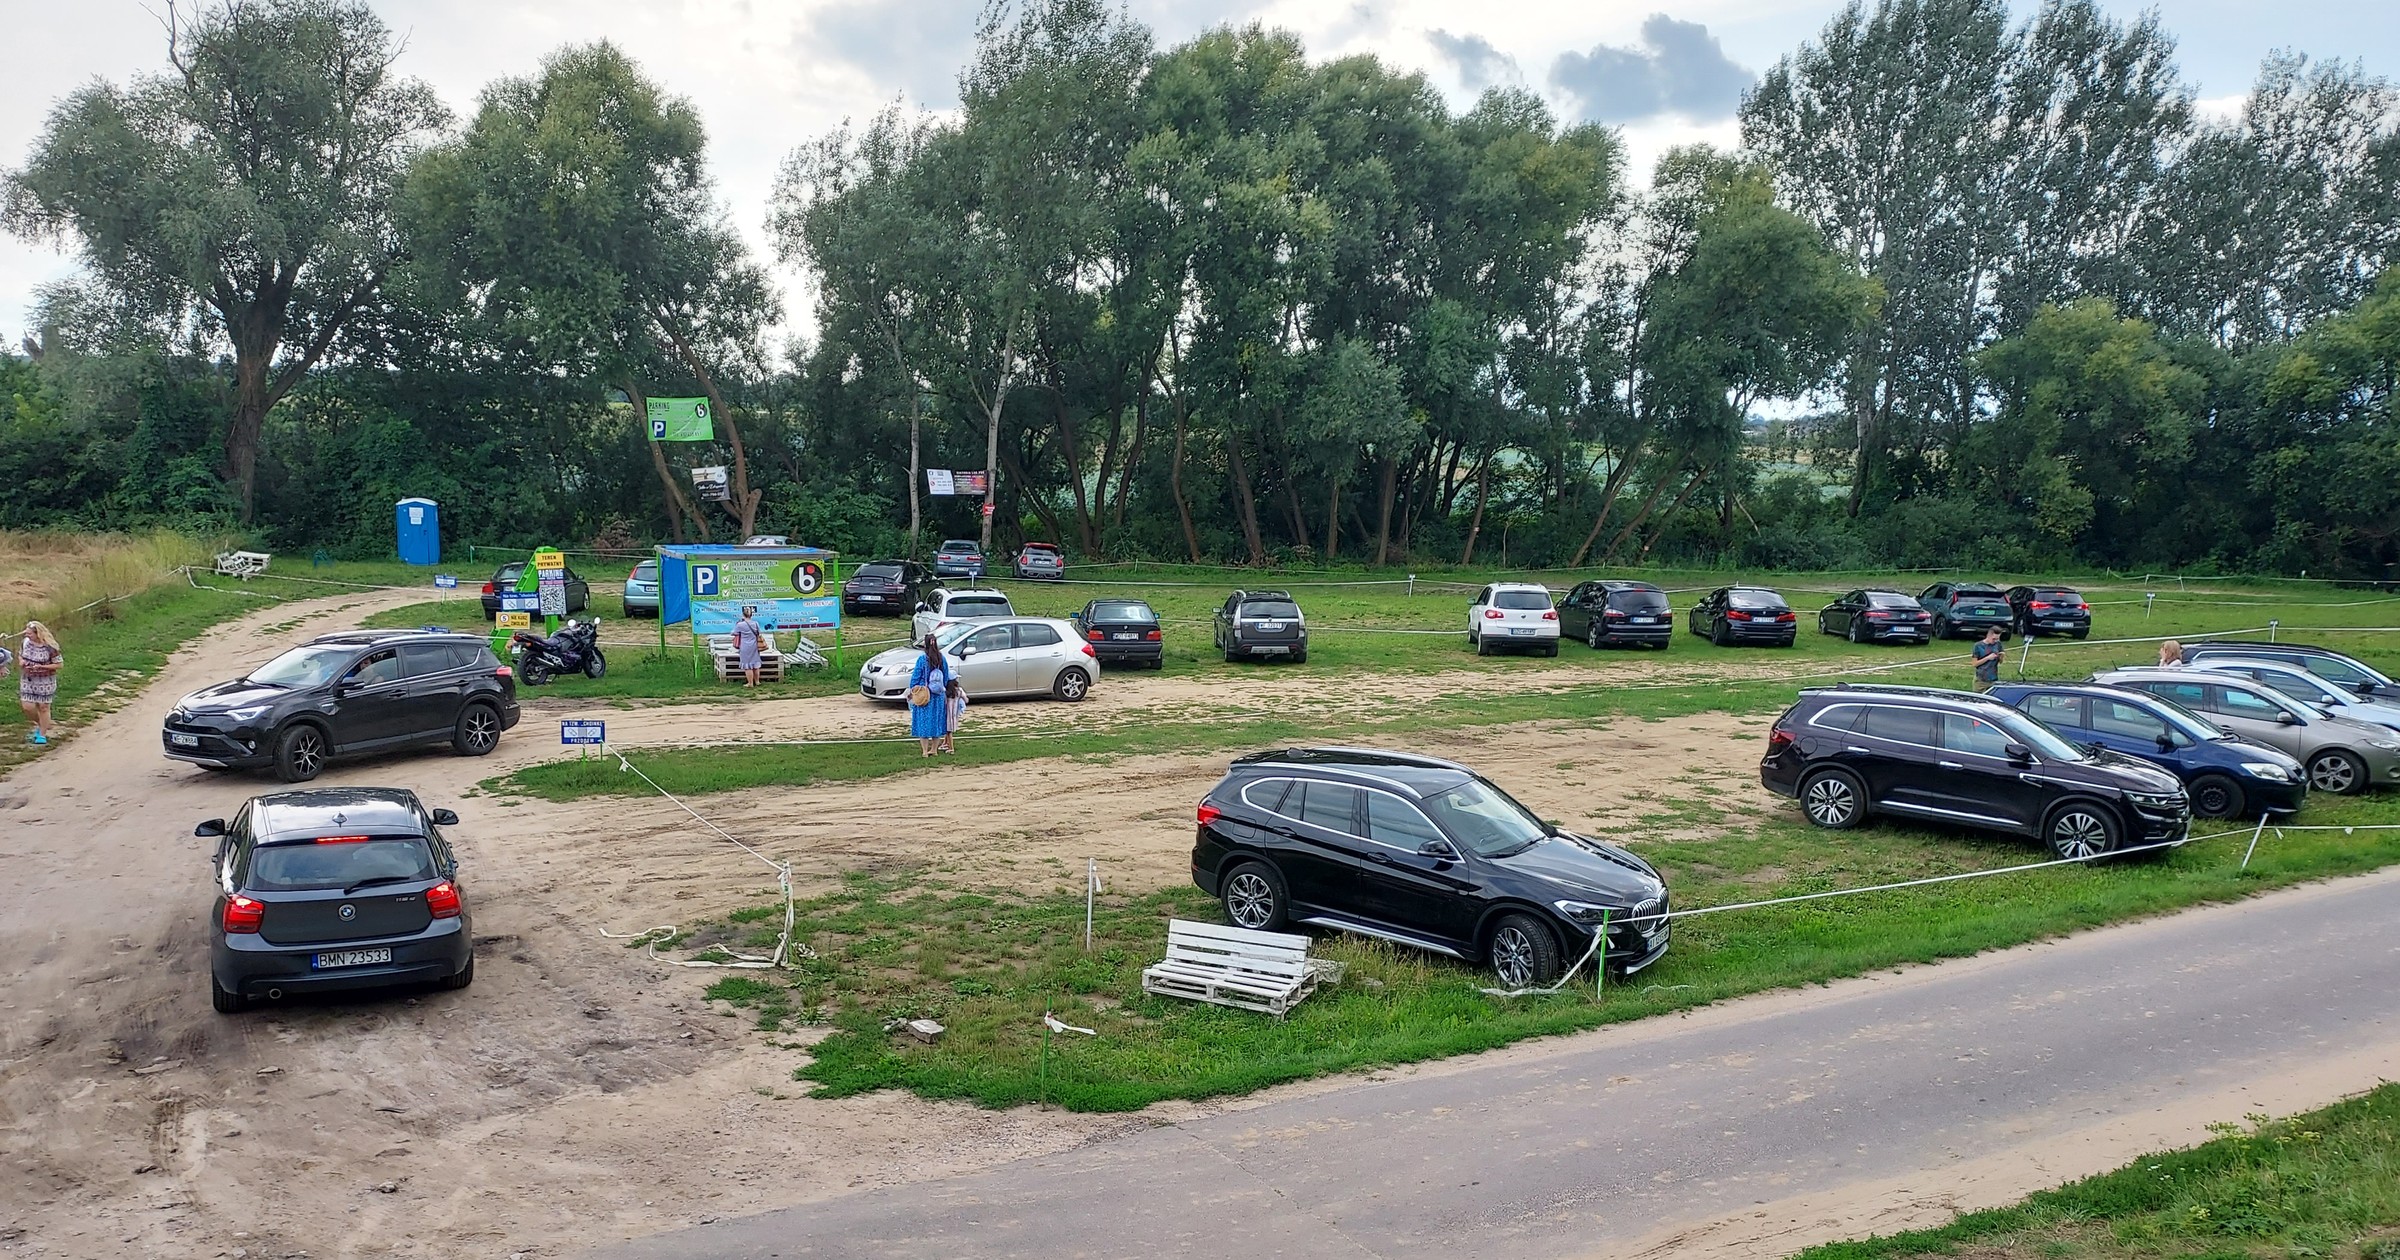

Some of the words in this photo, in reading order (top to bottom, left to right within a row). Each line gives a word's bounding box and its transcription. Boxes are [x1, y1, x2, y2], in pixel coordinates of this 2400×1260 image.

[654, 421, 665, 437] P
[538, 569, 564, 577] PARKING
[697, 567, 714, 594] P
[319, 953, 346, 967] BMN
[349, 948, 390, 964] 23533
